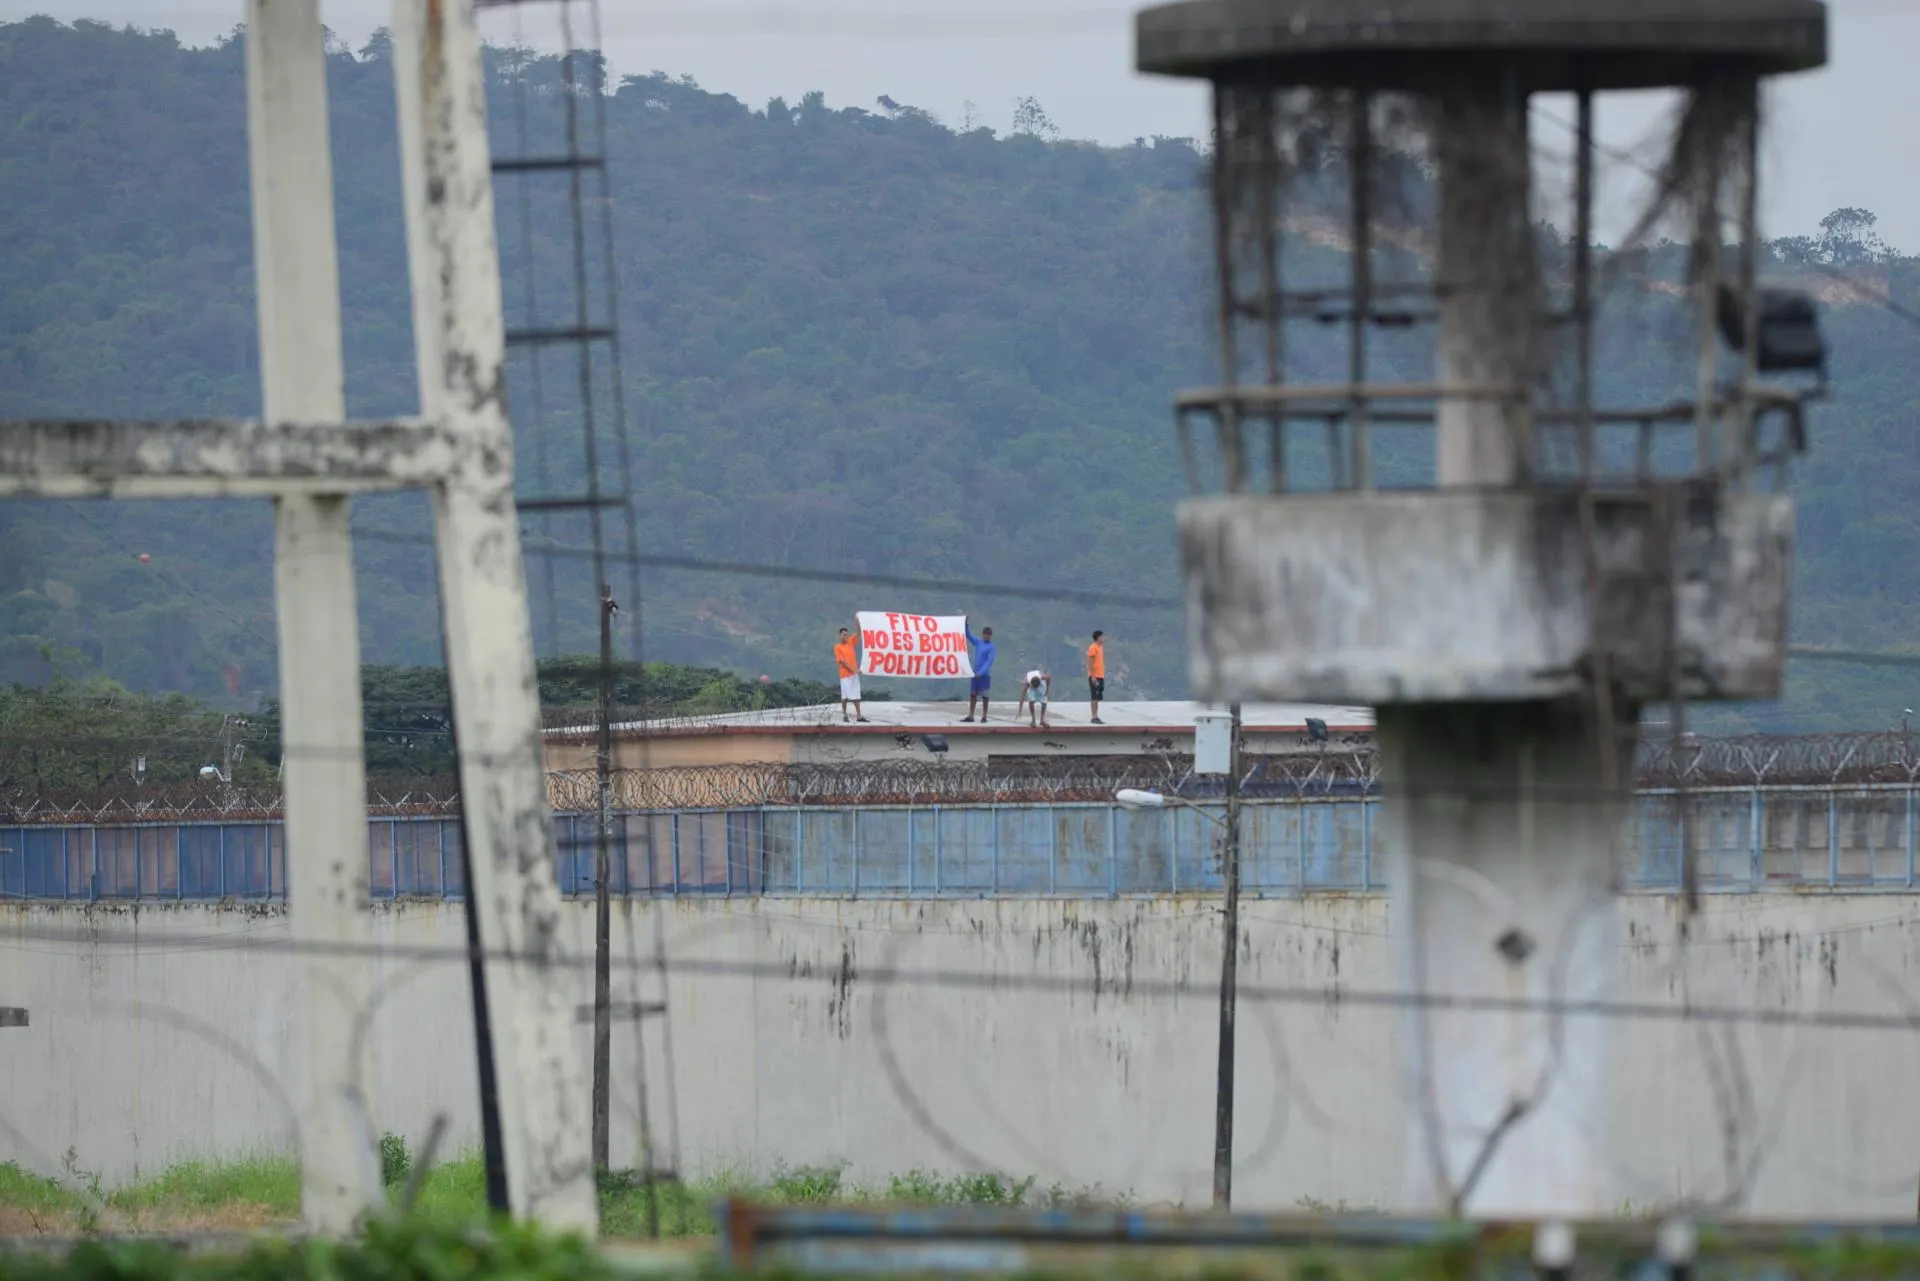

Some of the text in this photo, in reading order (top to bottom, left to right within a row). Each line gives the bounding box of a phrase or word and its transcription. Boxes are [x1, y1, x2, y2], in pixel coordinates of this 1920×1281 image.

[885, 612, 938, 632] FITO
[863, 630, 967, 653] NO ES BOTIN
[868, 651, 959, 676] POLITICO
